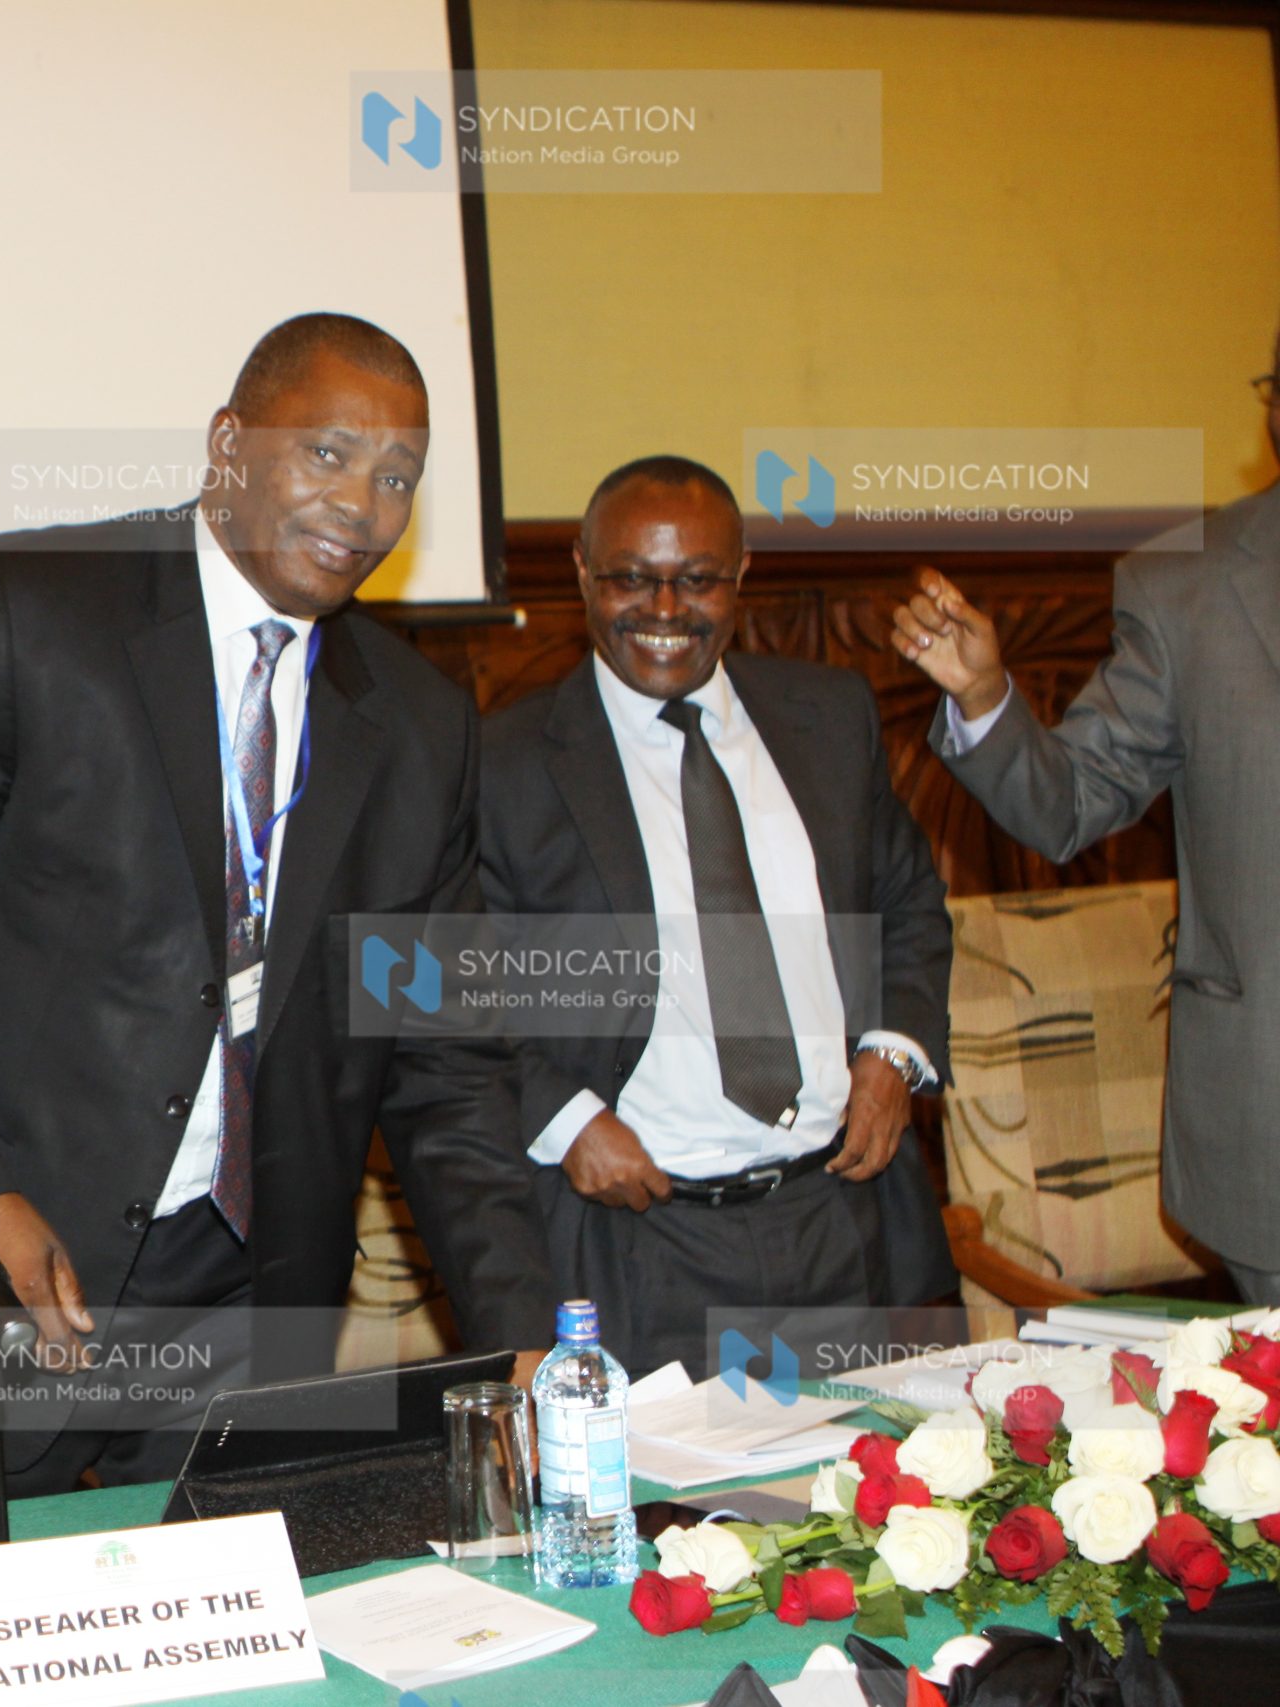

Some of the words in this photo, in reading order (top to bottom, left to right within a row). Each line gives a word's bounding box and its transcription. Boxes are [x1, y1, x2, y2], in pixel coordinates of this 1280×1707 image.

[152, 1599, 190, 1623] OF
[200, 1589, 265, 1616] THE
[142, 1628, 308, 1670] ASSEMBLY
